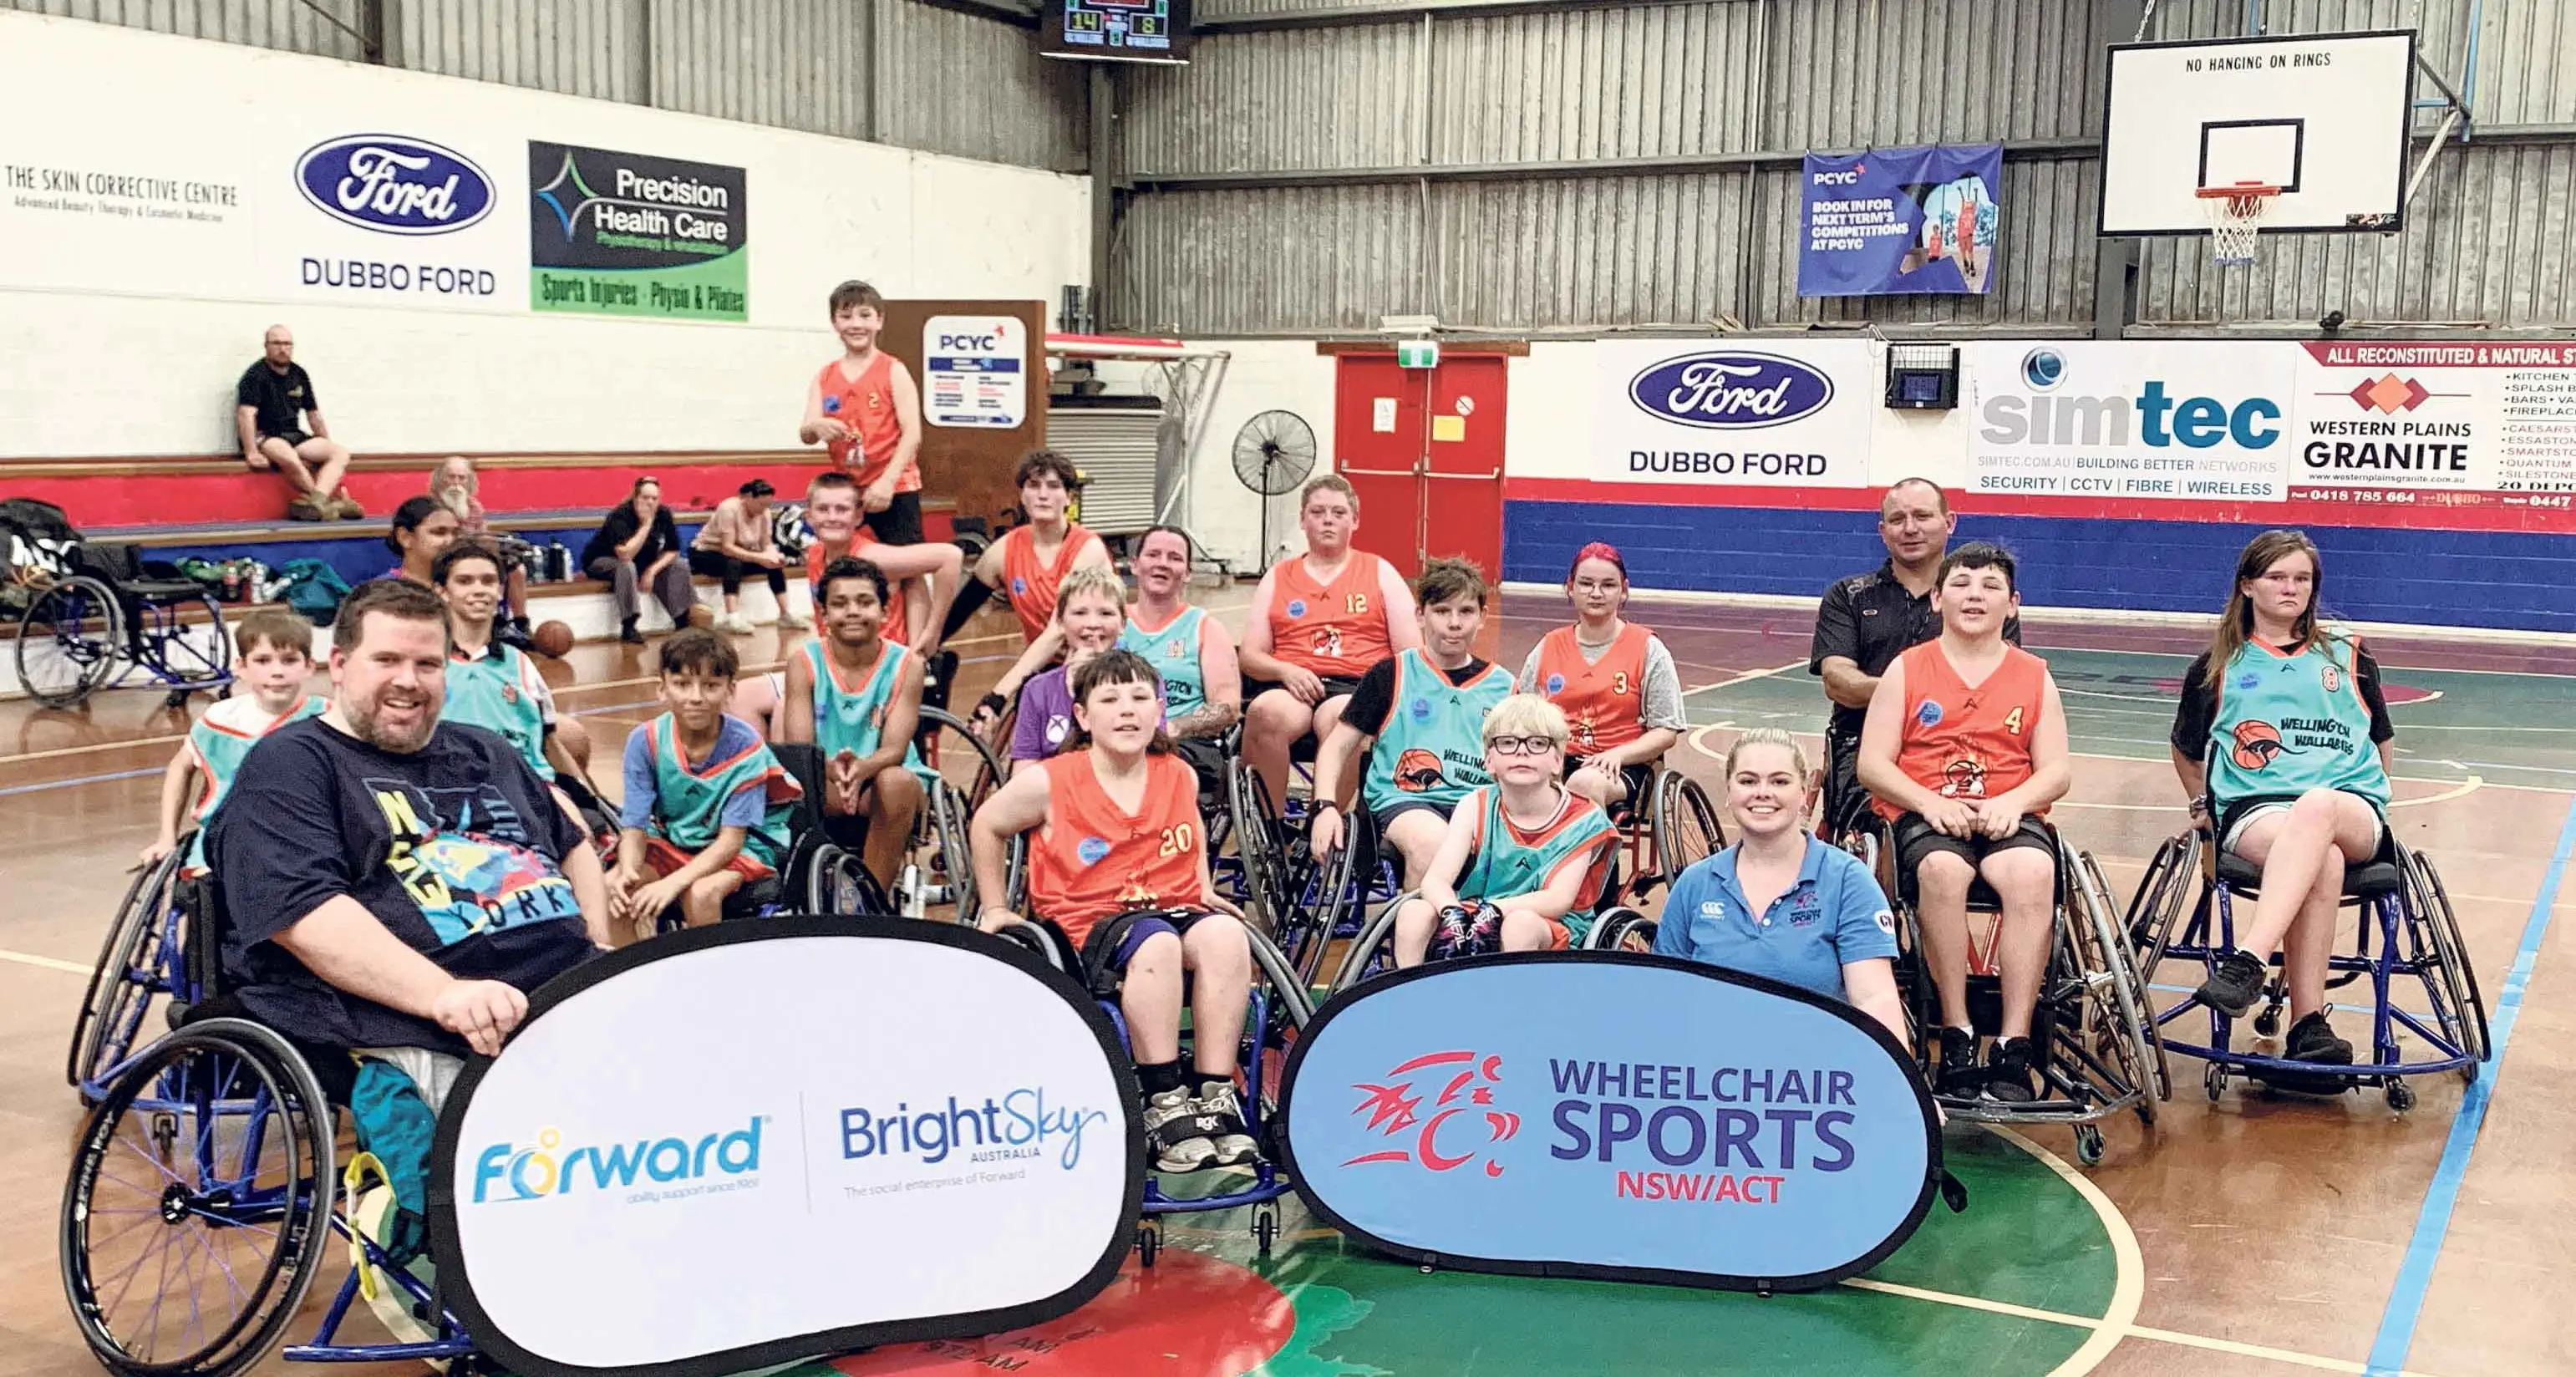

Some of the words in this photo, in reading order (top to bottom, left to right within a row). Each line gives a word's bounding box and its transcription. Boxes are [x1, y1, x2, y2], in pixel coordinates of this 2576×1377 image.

[1072, 13, 1097, 30] 14
[1141, 17, 1156, 34] 8
[2186, 58, 2202, 73] NO
[2209, 55, 2262, 71] HANGING
[2269, 54, 2286, 69] ON
[2294, 52, 2331, 67] RINGS
[6, 165, 36, 190] THE
[42, 169, 80, 192] SKIN
[86, 172, 179, 201] CORRECTIVE
[185, 181, 239, 207] CENTRE
[337, 145, 459, 222] Ford
[616, 169, 728, 208] Precision
[1813, 171, 1858, 185] PCYC
[1812, 201, 1850, 214] BOOK
[1851, 201, 1867, 211] IN
[1867, 198, 1893, 211] FOR
[594, 204, 670, 235] Health
[674, 212, 728, 241] Care
[1811, 222, 1909, 238] COMPETITIONS
[1812, 214, 1848, 226] NEXT
[1811, 239, 1827, 251] AT
[1828, 238, 1864, 251] PCYC
[302, 257, 410, 292] DUBBO
[419, 266, 496, 296] FORD
[541, 273, 585, 307] Sports
[589, 277, 638, 309] Injuries
[650, 282, 690, 312] Physio
[709, 286, 744, 312] Pilates
[940, 335, 995, 351] PCYC
[2327, 348, 2354, 363] ALL
[2357, 348, 2474, 363] RECONSTITUTED
[2477, 348, 2488, 363] &
[2492, 348, 2561, 364] NATURAL
[2512, 373, 2569, 381] KITCHEN
[1668, 362, 1792, 416] Ford
[2512, 384, 2563, 393] SPLASH
[869, 392, 879, 409] 2
[2511, 395, 2547, 404] BARS
[1980, 380, 2281, 450] simtec
[2310, 421, 2396, 435] WESTERN
[2403, 423, 2472, 437] PLAINS
[1629, 450, 1735, 475] DUBBO
[1743, 453, 1827, 476] FORD
[1978, 455, 2070, 469] SIMTEC.COM.AU
[2076, 457, 2139, 470] BUILDING
[2144, 459, 2195, 470] BETTER
[2199, 460, 2277, 473] NETWORKS
[2304, 441, 2468, 470] GRANITE
[2507, 459, 2572, 468] QUANTUM
[1980, 475, 2057, 490] SECURITY
[2070, 477, 2113, 491] CCTV
[2126, 479, 2172, 492] FIBRE
[2187, 481, 2273, 495] WIRELESS
[2497, 481, 2522, 490] 20
[2310, 490, 2349, 500] 0418
[2353, 490, 2381, 502] 785
[2386, 491, 2416, 503] 664
[2529, 495, 2572, 506] 0447
[1345, 593, 1368, 613] 12
[1613, 672, 1628, 695] 3
[2322, 665, 2340, 693] 8
[2004, 706, 2025, 735] 4
[2280, 717, 2350, 738] WELLINGTON
[2294, 734, 2355, 755] WALLABIES
[1159, 822, 1193, 858] 20
[449, 886, 567, 931] YORK
[1550, 1058, 1857, 1105] WHEELCHAIR
[841, 1087, 1107, 1171] BrightSky
[1550, 1100, 1856, 1171] SPORTS
[472, 1115, 763, 1204] Forward
[970, 1147, 1041, 1164] AUSTRALIA
[844, 1186, 867, 1200] The
[869, 1181, 902, 1196] social
[905, 1176, 963, 1192] enterprise
[966, 1172, 978, 1184] of
[980, 1168, 1026, 1183] Forward
[1617, 1171, 1786, 1204] NSW/ACT
